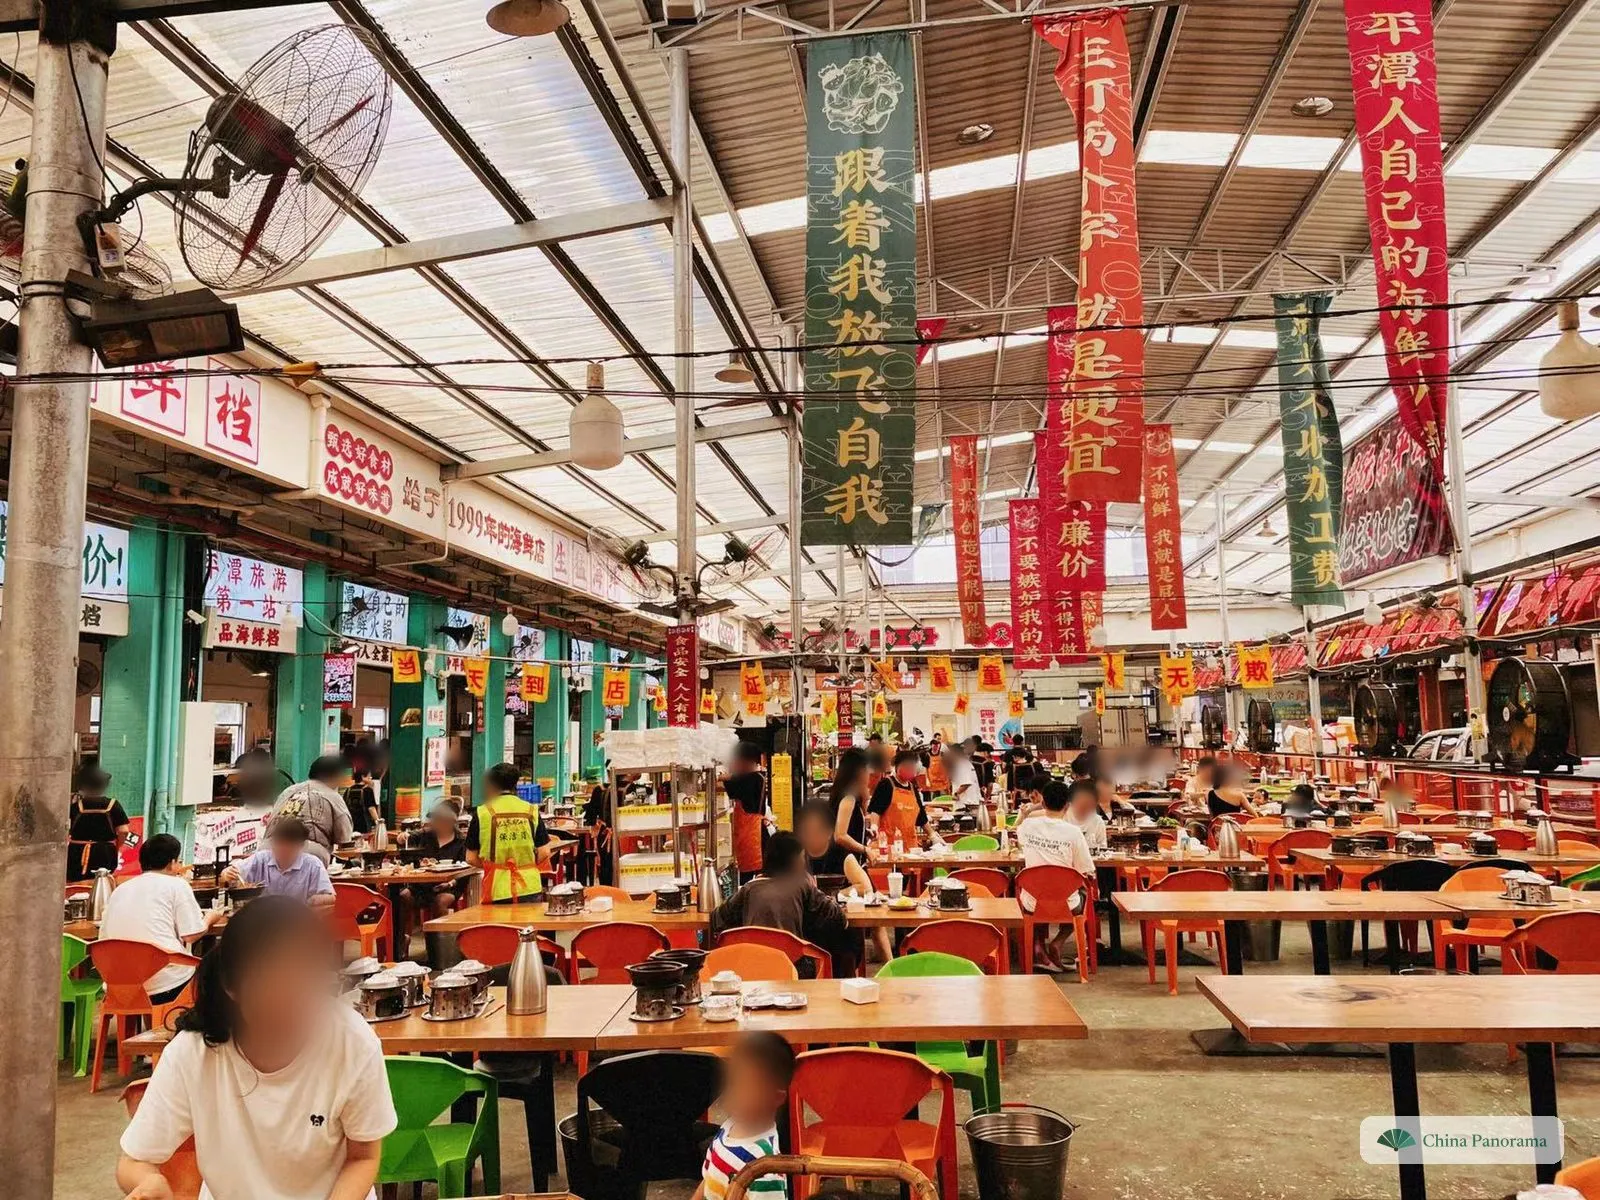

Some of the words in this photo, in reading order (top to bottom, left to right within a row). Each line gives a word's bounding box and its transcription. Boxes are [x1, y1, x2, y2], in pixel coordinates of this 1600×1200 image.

[1363, 11, 1441, 459] 平潭人自己的海鲜
[824, 146, 896, 525] 跟着我放飞自我
[326, 430, 392, 476] 甄选好食材
[326, 466, 392, 512] 成就好味道
[1149, 464, 1173, 517] 不新鲜
[957, 477, 983, 640] 真诚创造无限可能
[216, 585, 277, 620] 第一站
[1017, 536, 1045, 663] 不要嫉妒我的美
[80, 604, 102, 627] 档
[218, 622, 280, 648] 品海鲜档
[397, 656, 416, 676] 当
[673, 635, 690, 678] 食品安全
[1244, 659, 1269, 682] 欺
[468, 668, 484, 690] 天
[525, 674, 545, 695] 到
[606, 678, 625, 700] 店
[744, 675, 763, 695] 证
[982, 664, 1003, 686] 童
[1167, 667, 1190, 689] 无
[673, 682, 692, 723] 人人有责
